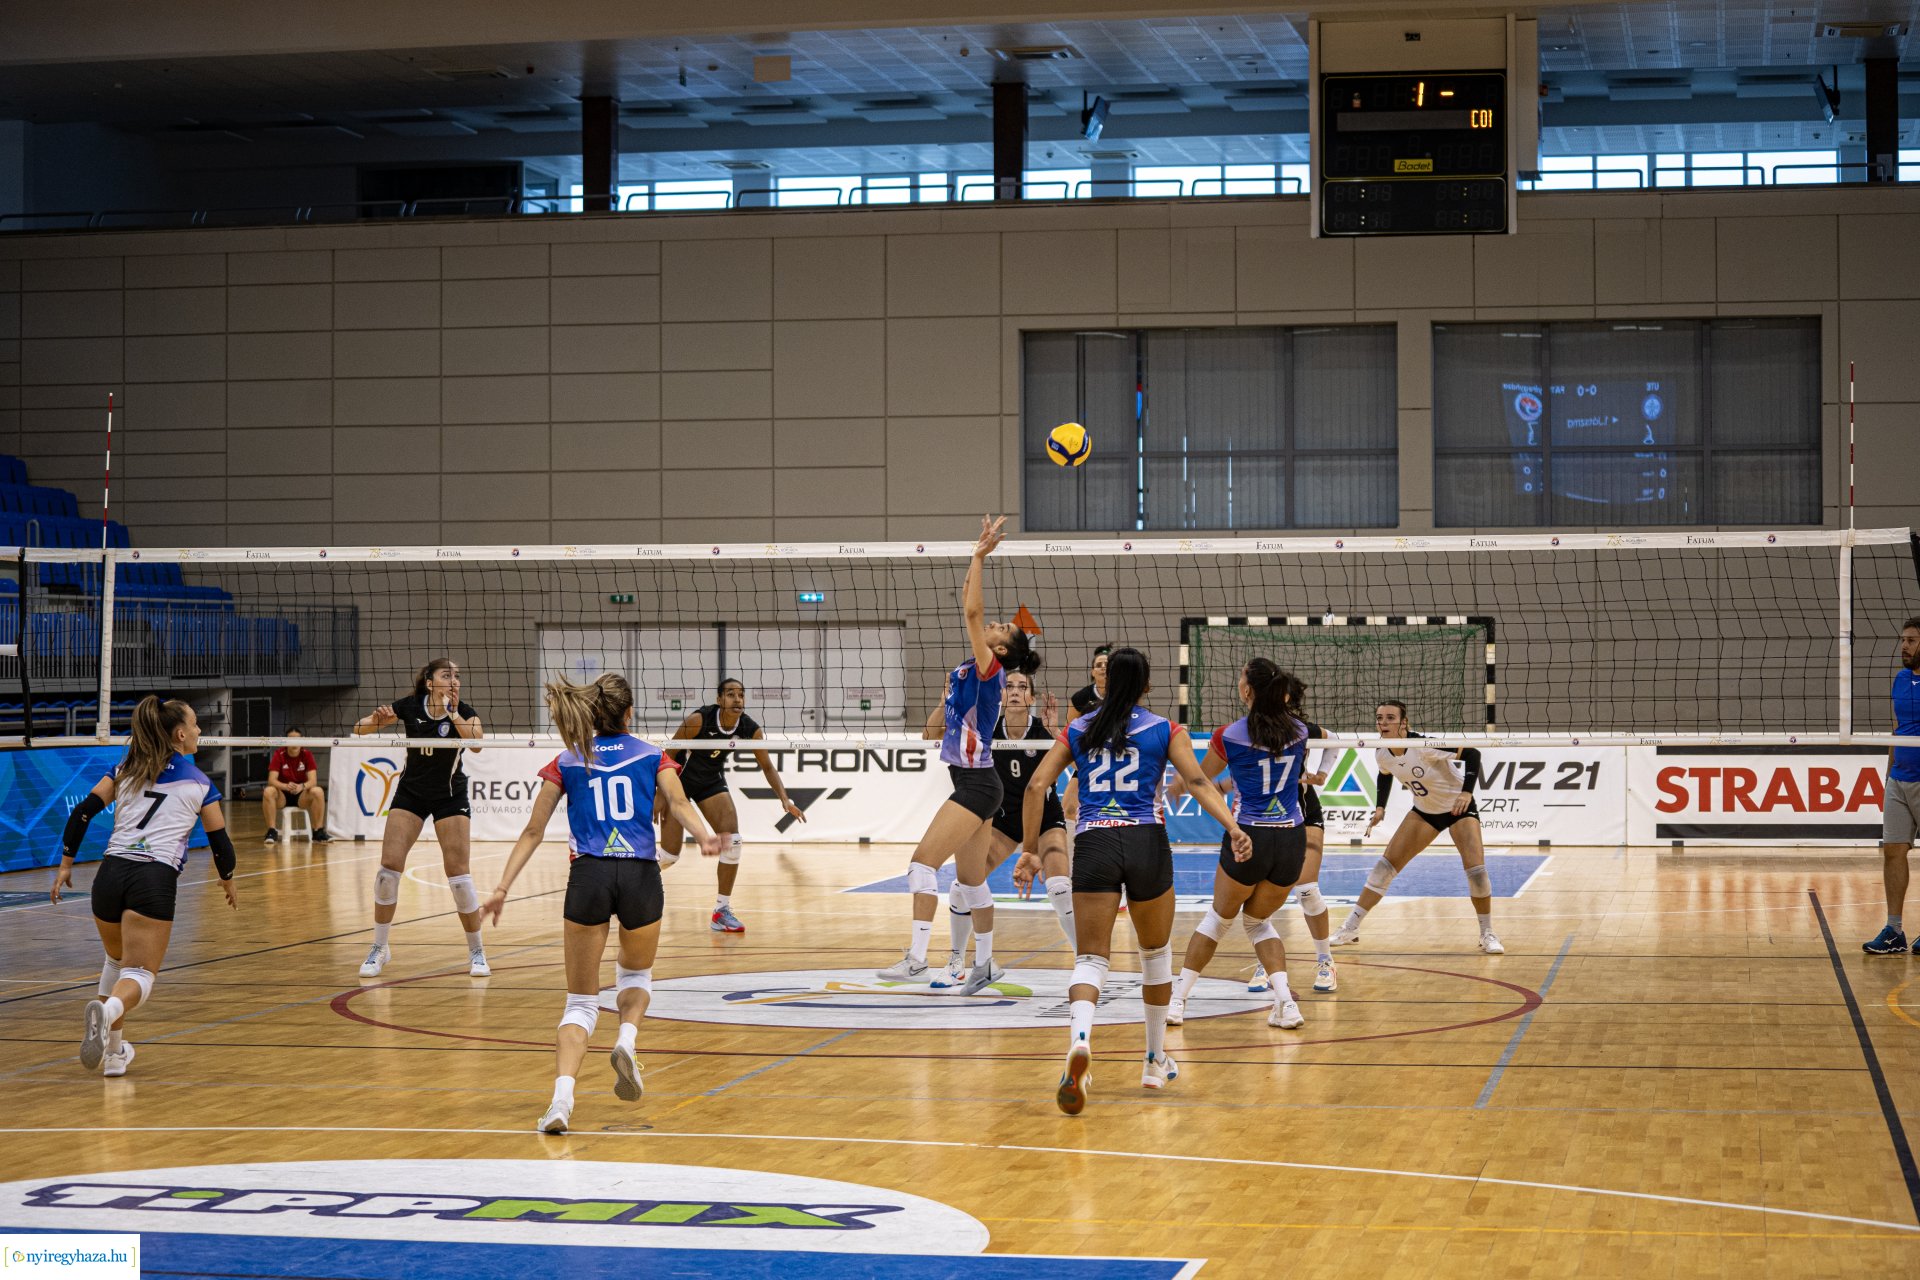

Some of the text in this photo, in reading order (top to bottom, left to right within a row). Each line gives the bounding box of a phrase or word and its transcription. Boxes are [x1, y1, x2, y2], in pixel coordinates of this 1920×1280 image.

[1396, 160, 1432, 171] Bodet
[1010, 759, 1021, 778] 9
[1088, 746, 1140, 793] 22
[1257, 755, 1296, 795] 17
[1553, 761, 1601, 790] 21
[588, 775, 635, 821] 10
[1405, 780, 1429, 797] 19
[1655, 766, 1885, 813] STRABA
[136, 790, 168, 830] 7
[1479, 798, 1520, 812] ZRT.
[1480, 819, 1538, 829] APÍTVA 1991
